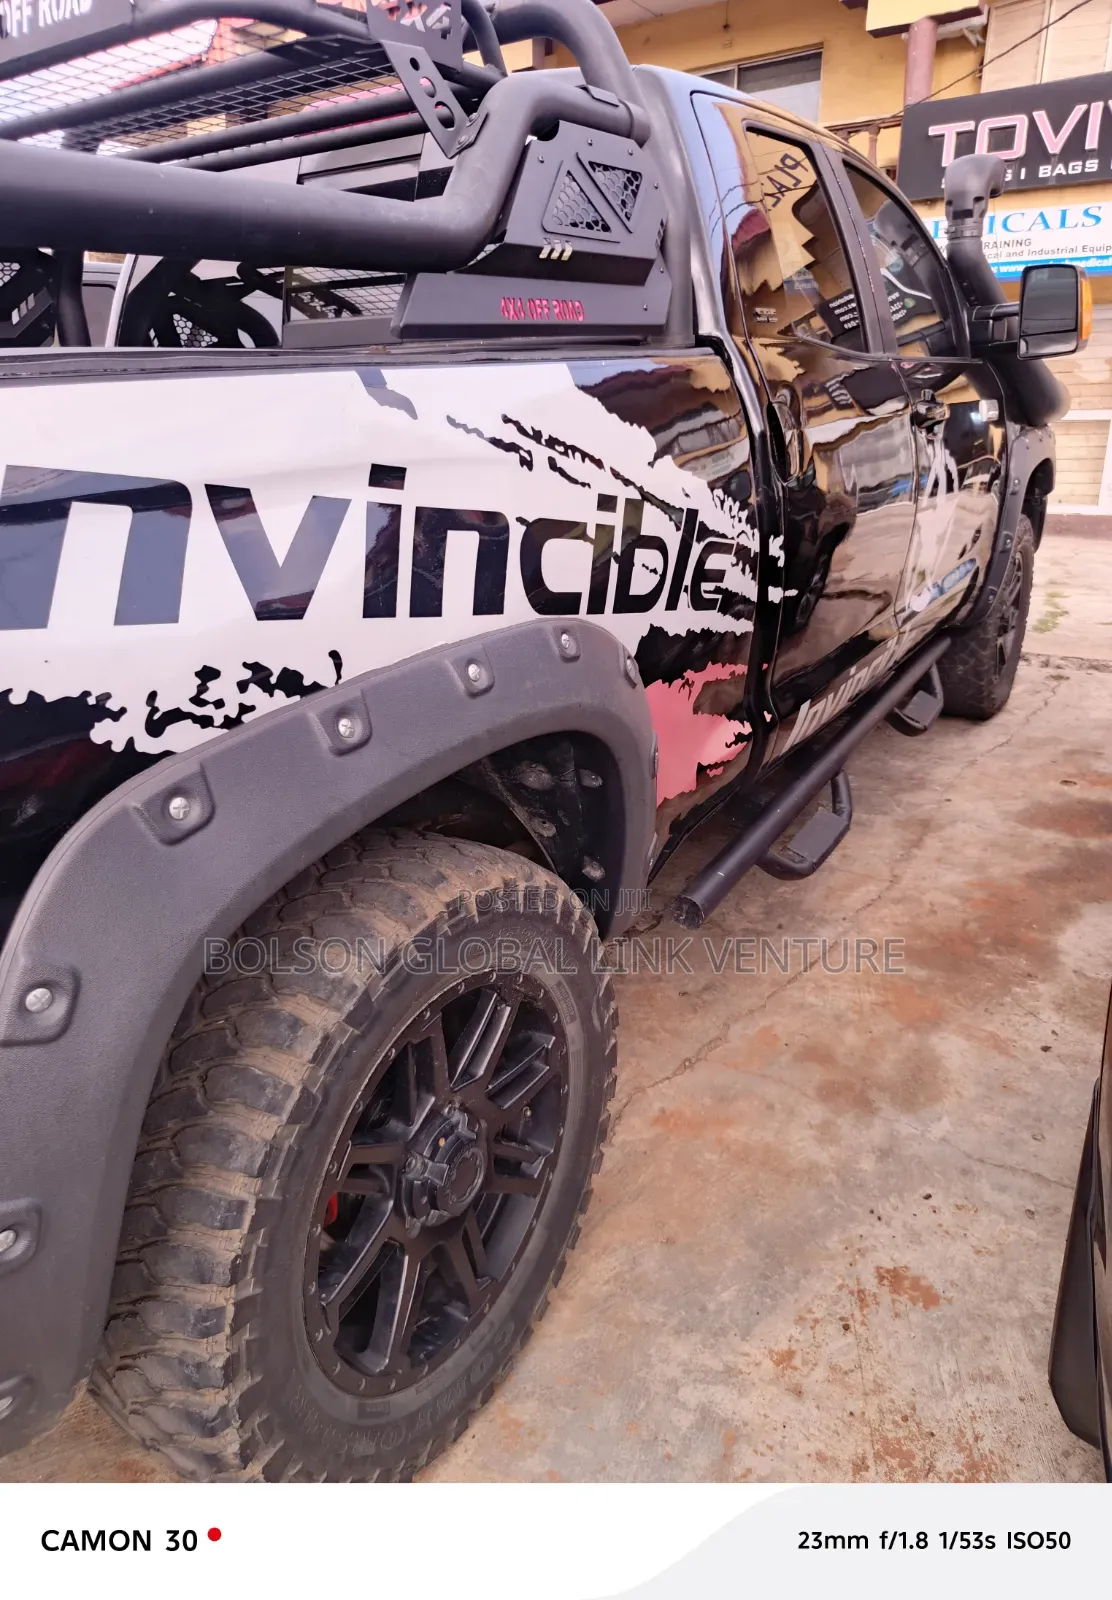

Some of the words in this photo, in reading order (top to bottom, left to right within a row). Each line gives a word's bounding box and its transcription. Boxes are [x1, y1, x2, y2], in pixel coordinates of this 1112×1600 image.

[928, 99, 1112, 168] TOVI
[1038, 159, 1099, 178] BAGS
[931, 204, 1103, 240] EICALS
[1006, 249, 1025, 259] and
[1027, 244, 1079, 258] Industrial
[527, 298, 550, 321] OFF
[552, 299, 585, 322] ROAD
